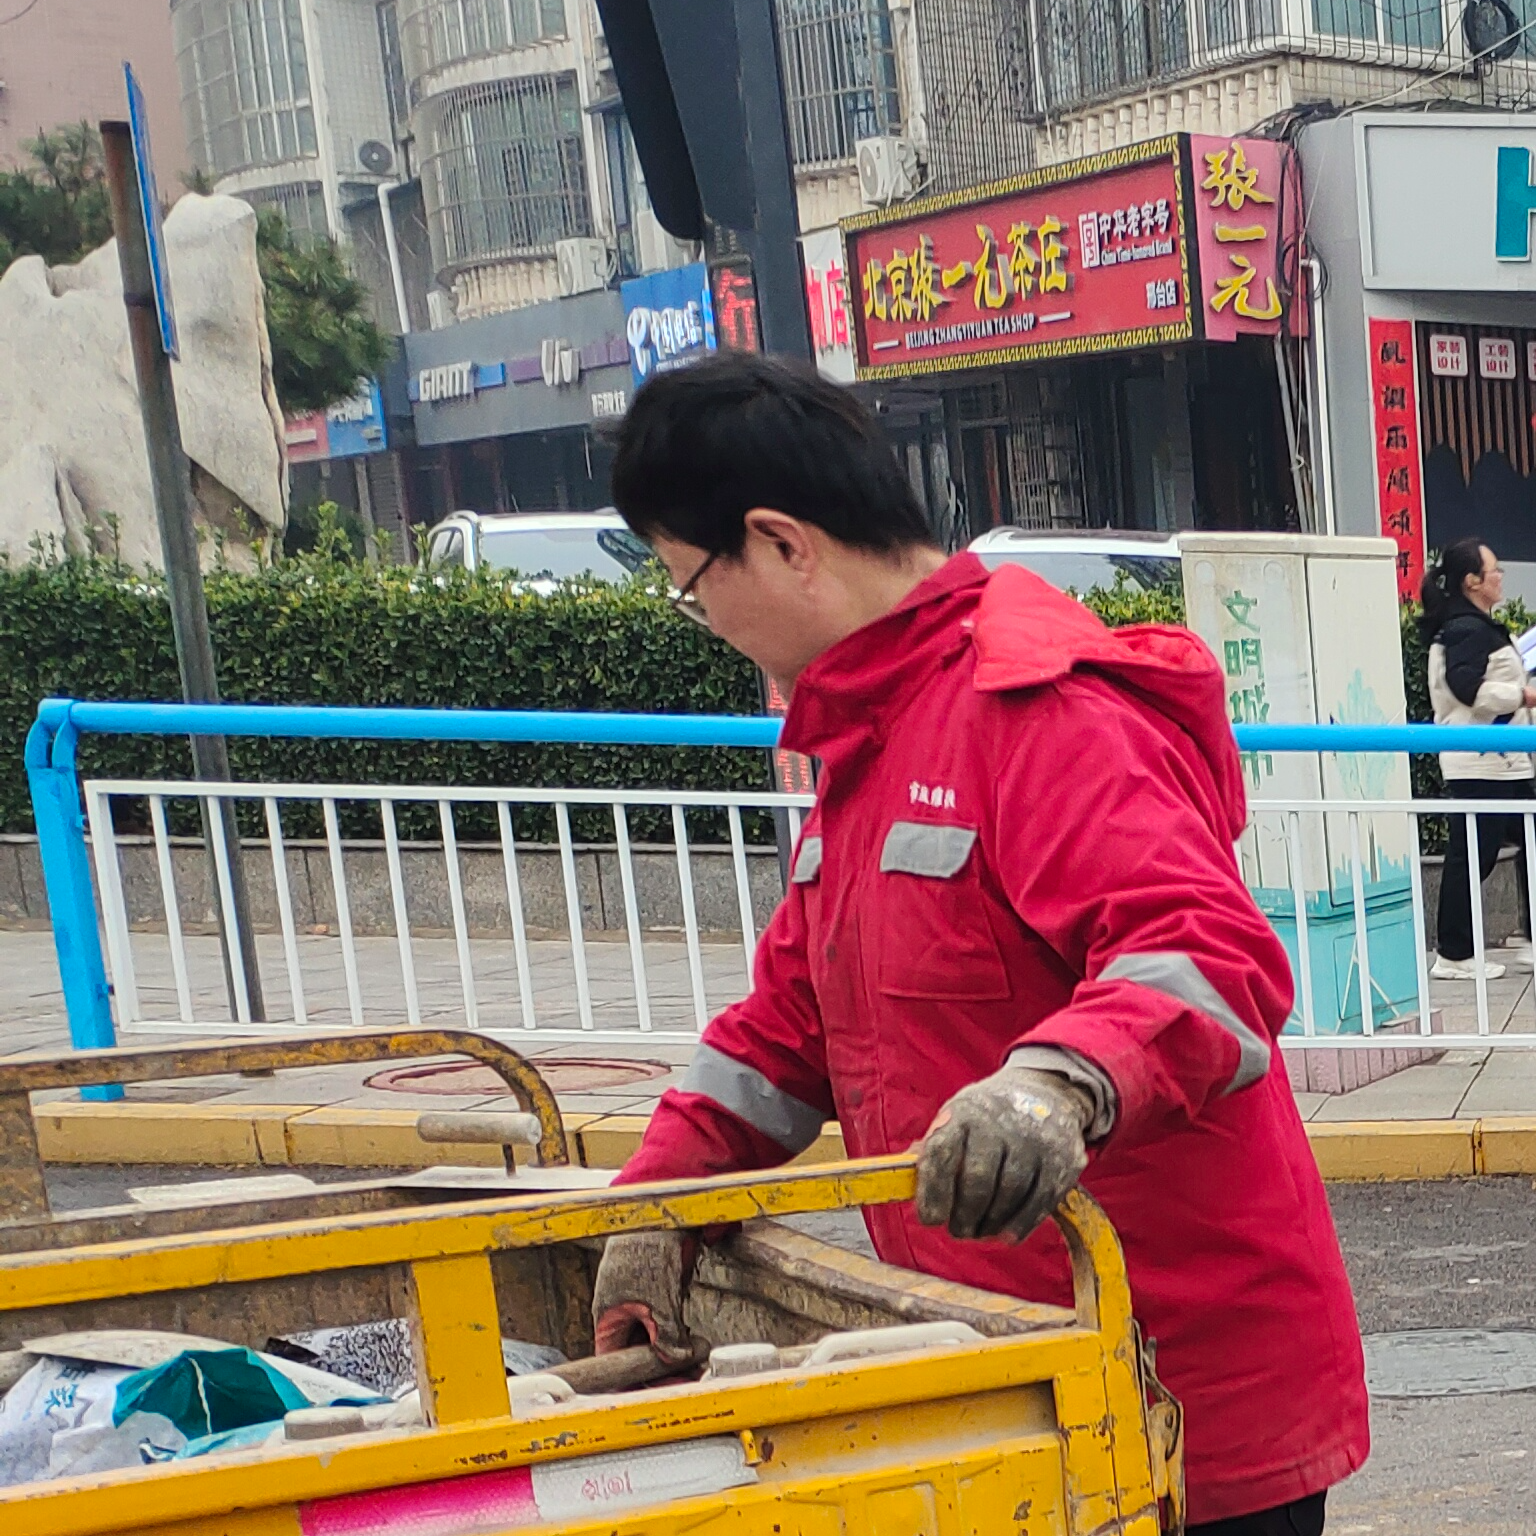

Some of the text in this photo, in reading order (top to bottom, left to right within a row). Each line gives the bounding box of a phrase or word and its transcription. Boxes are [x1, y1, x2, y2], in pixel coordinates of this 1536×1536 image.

[1099, 199, 1170, 244] 中华老字号
[1009, 313, 1035, 332] SHOP
[1437, 356, 1461, 370] 设计
[1486, 360, 1509, 373] 设计
[419, 360, 473, 402] GIANT
